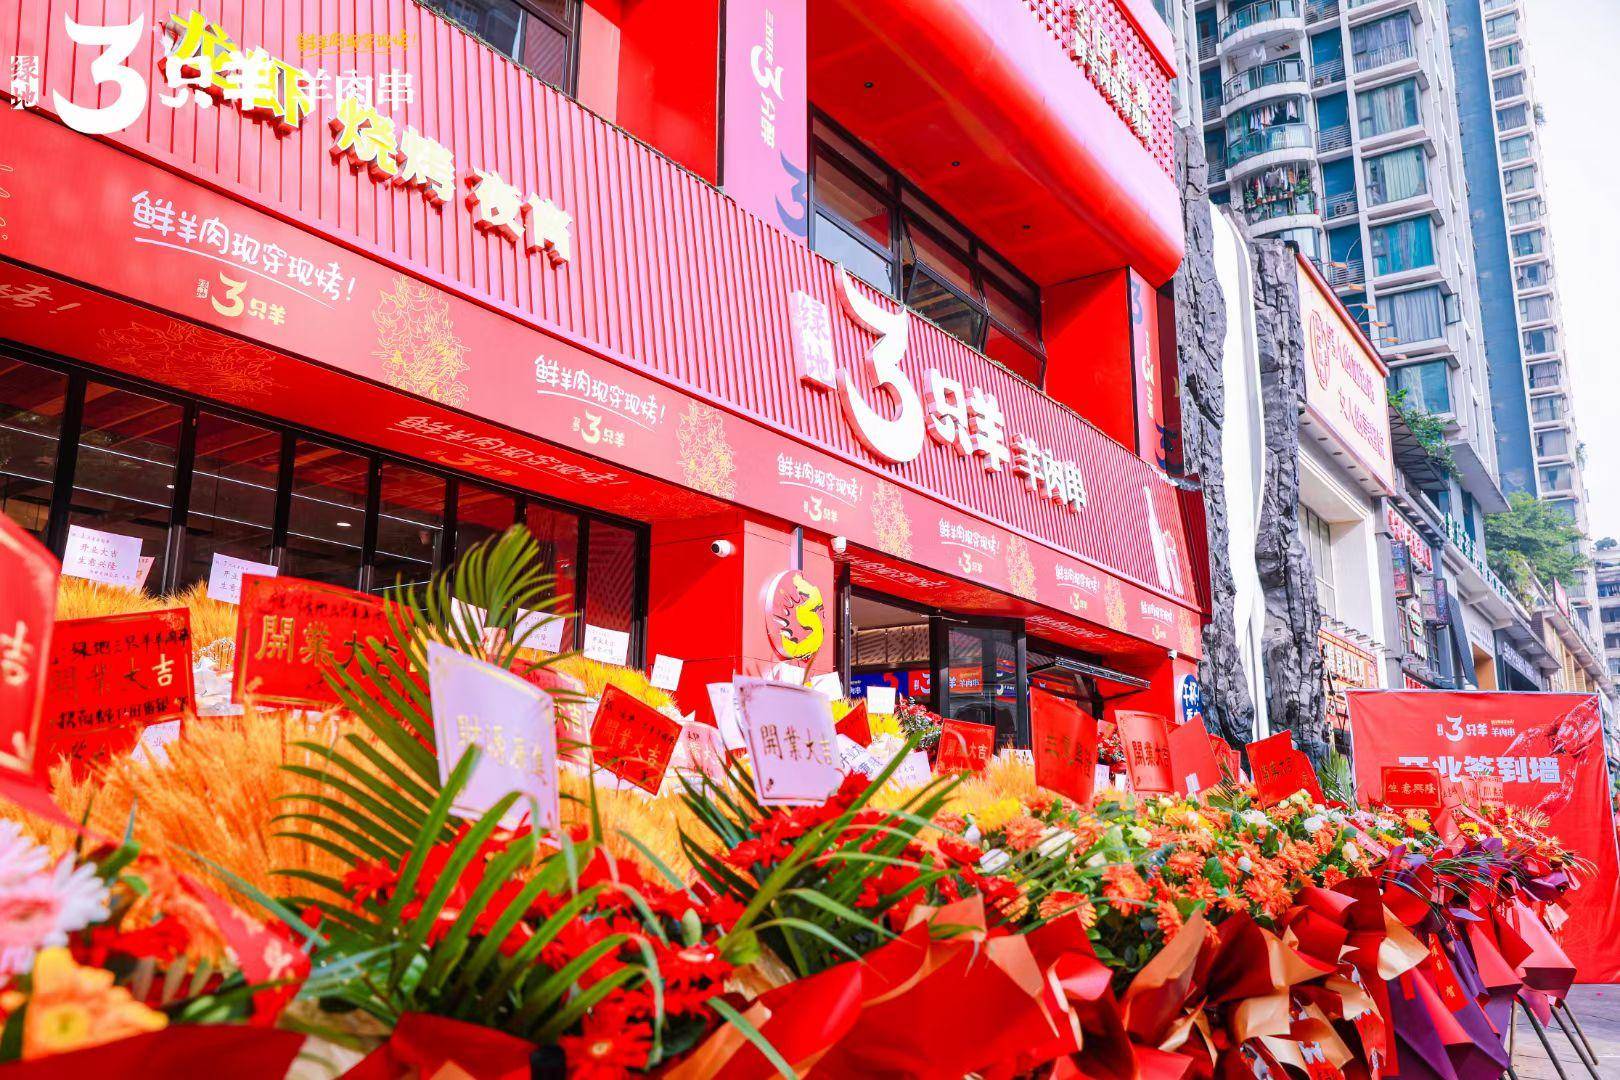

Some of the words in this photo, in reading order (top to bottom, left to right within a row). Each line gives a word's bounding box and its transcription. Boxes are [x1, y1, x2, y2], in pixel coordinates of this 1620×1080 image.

[131, 191, 356, 301] 鲜羊肉现穿现烤!
[211, 271, 287, 326] 3只羊
[534, 355, 666, 424] 鲜羊肉现穿现烤!
[835, 262, 1011, 474] 3只羊
[777, 452, 863, 504] 鲜羊肉现穿现烤!
[1010, 433, 1088, 514] 羊肉串
[760, 724, 833, 766] 開業大吉
[1445, 715, 1488, 742] 3只羊
